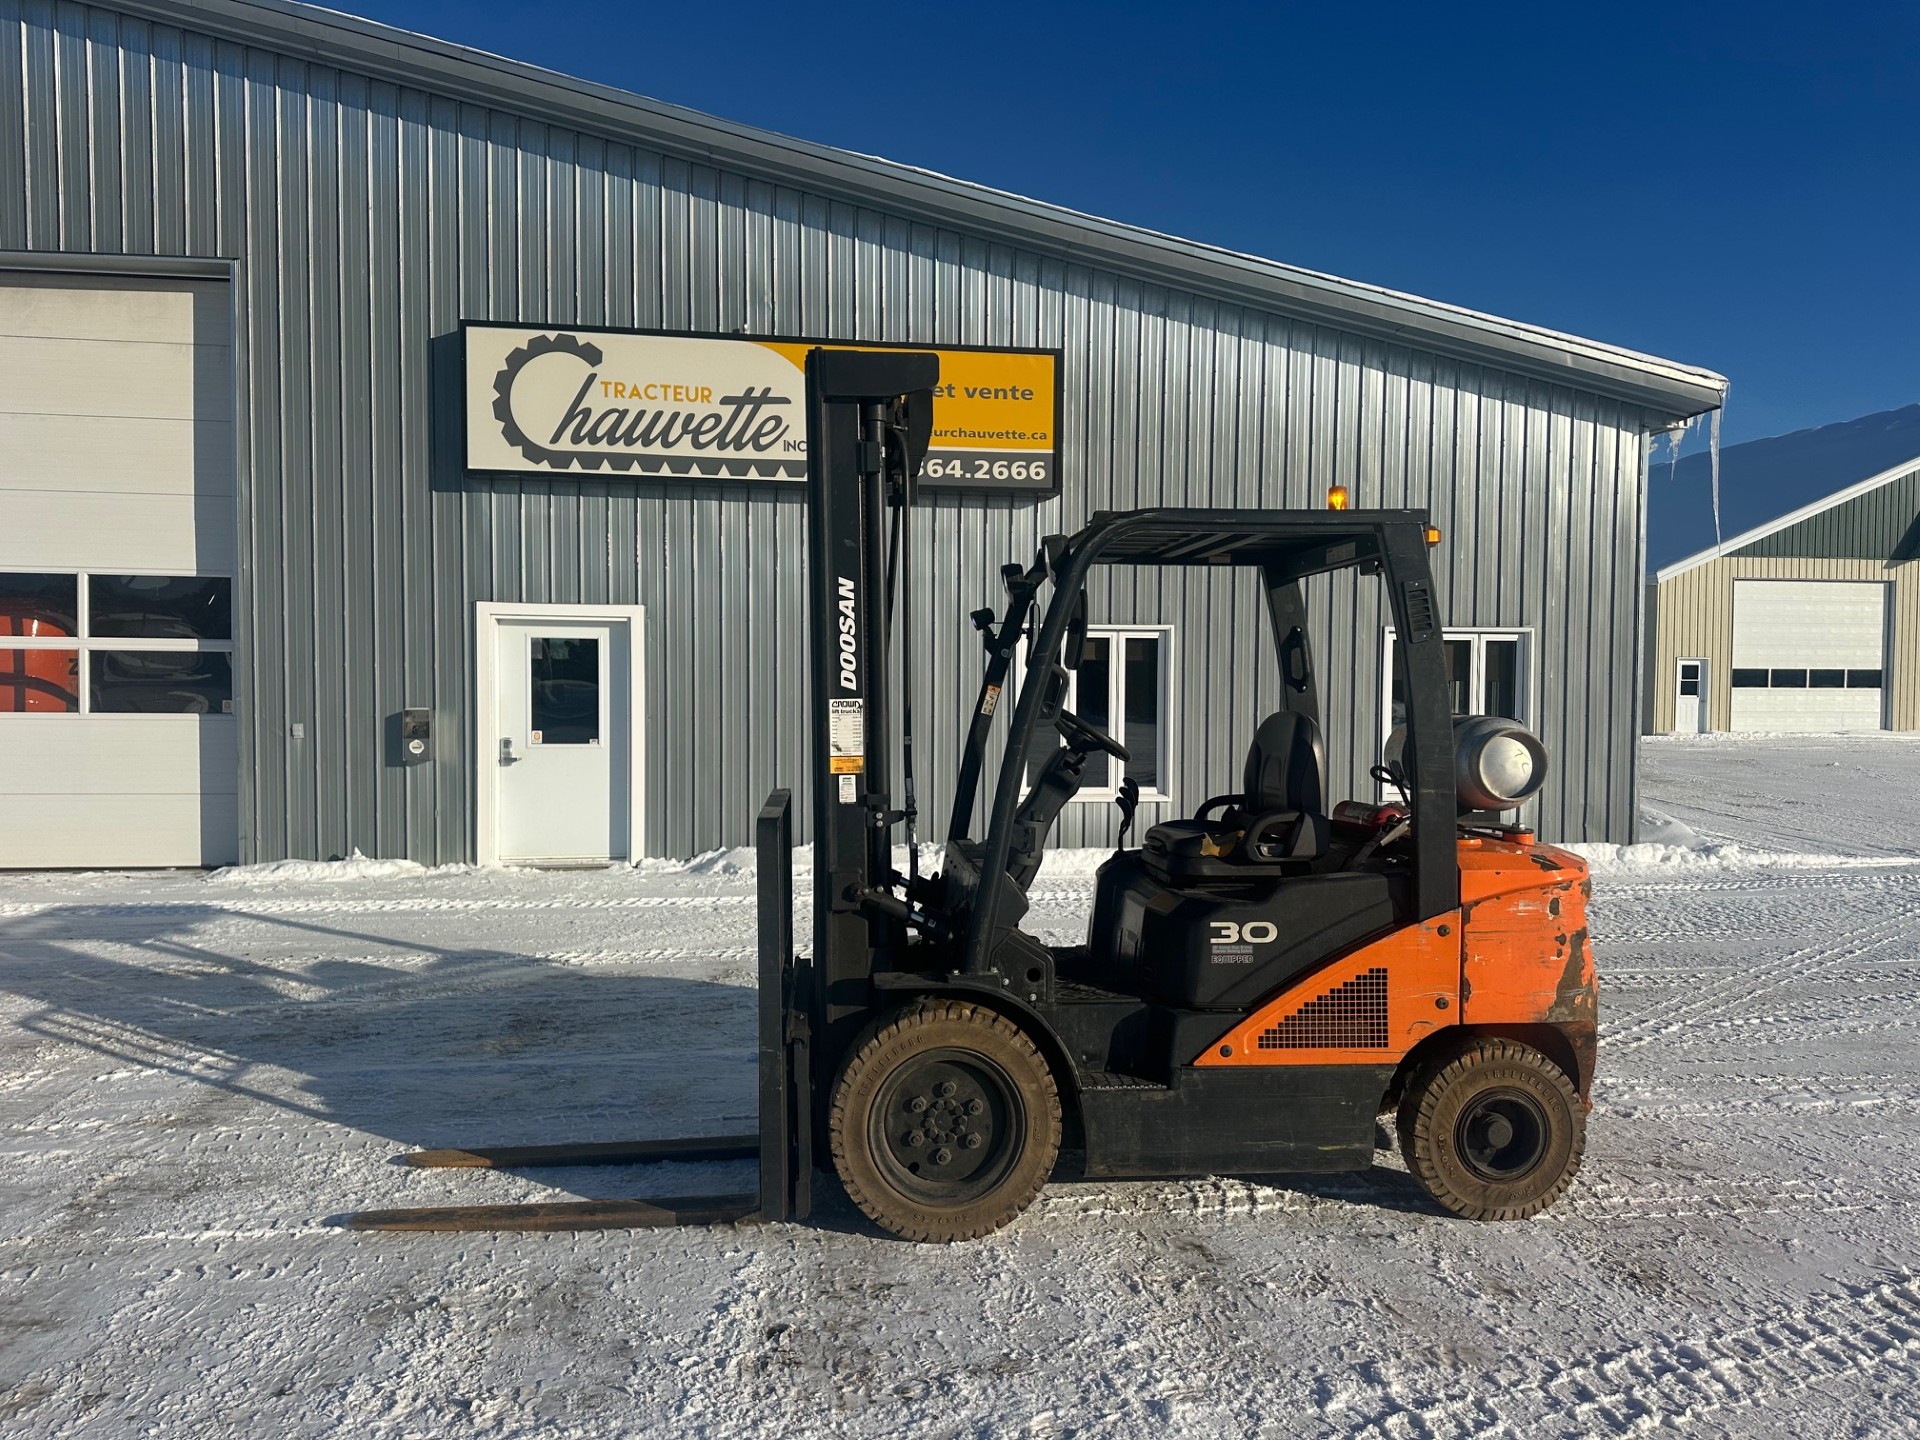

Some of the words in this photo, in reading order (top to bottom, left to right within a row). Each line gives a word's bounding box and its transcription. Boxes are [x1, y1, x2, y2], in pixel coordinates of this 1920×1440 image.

[600, 381, 712, 404] TRACTEUR
[932, 383, 955, 398] et
[964, 385, 1034, 400] vente
[930, 427, 1047, 440] urchauvette.ca
[838, 577, 857, 691] DOOSAN
[1209, 921, 1278, 944] 30
[1484, 1069, 1561, 1113] TRELLEBORG
